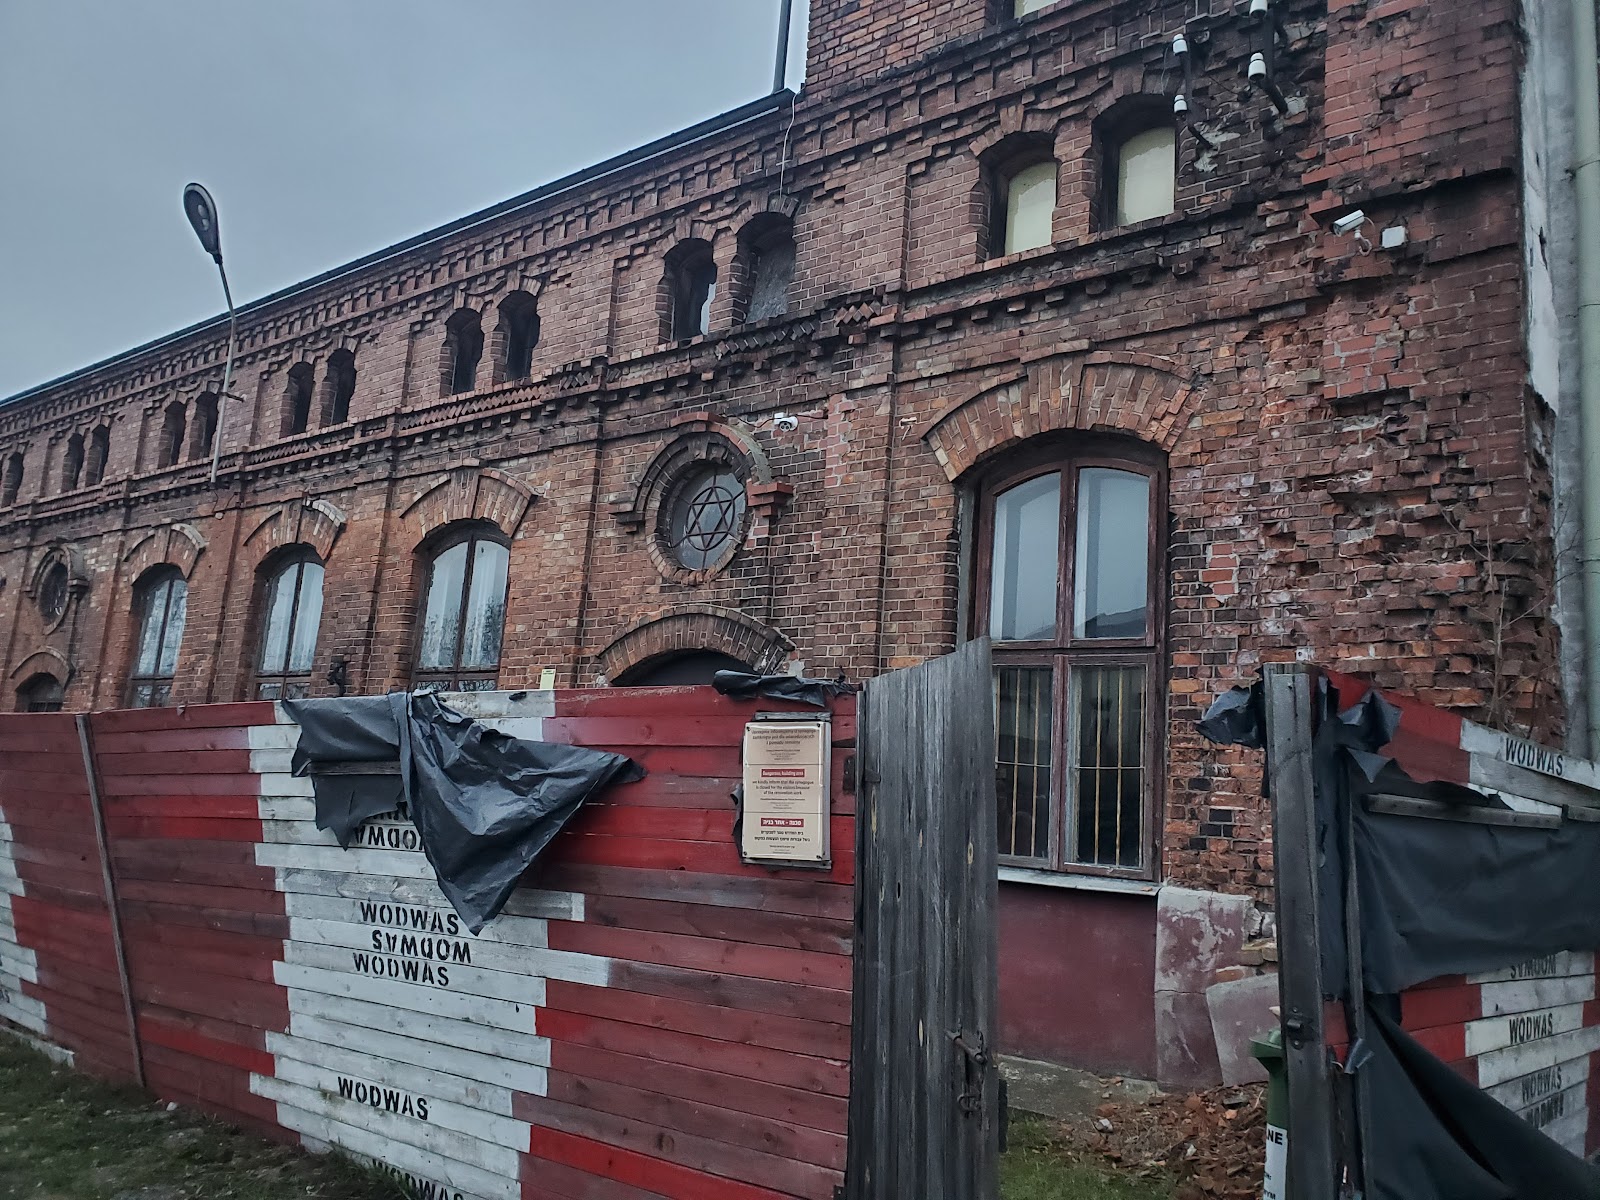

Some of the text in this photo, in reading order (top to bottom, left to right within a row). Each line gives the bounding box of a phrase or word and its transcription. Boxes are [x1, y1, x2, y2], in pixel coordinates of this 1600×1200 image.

[1505, 737, 1564, 776] WODWAS
[360, 901, 459, 936] WODWAS
[371, 929, 471, 964] WODWAS
[353, 952, 449, 987] WODWAS
[1509, 1012, 1553, 1045] WODWAS
[338, 1076, 429, 1121] WODWAS
